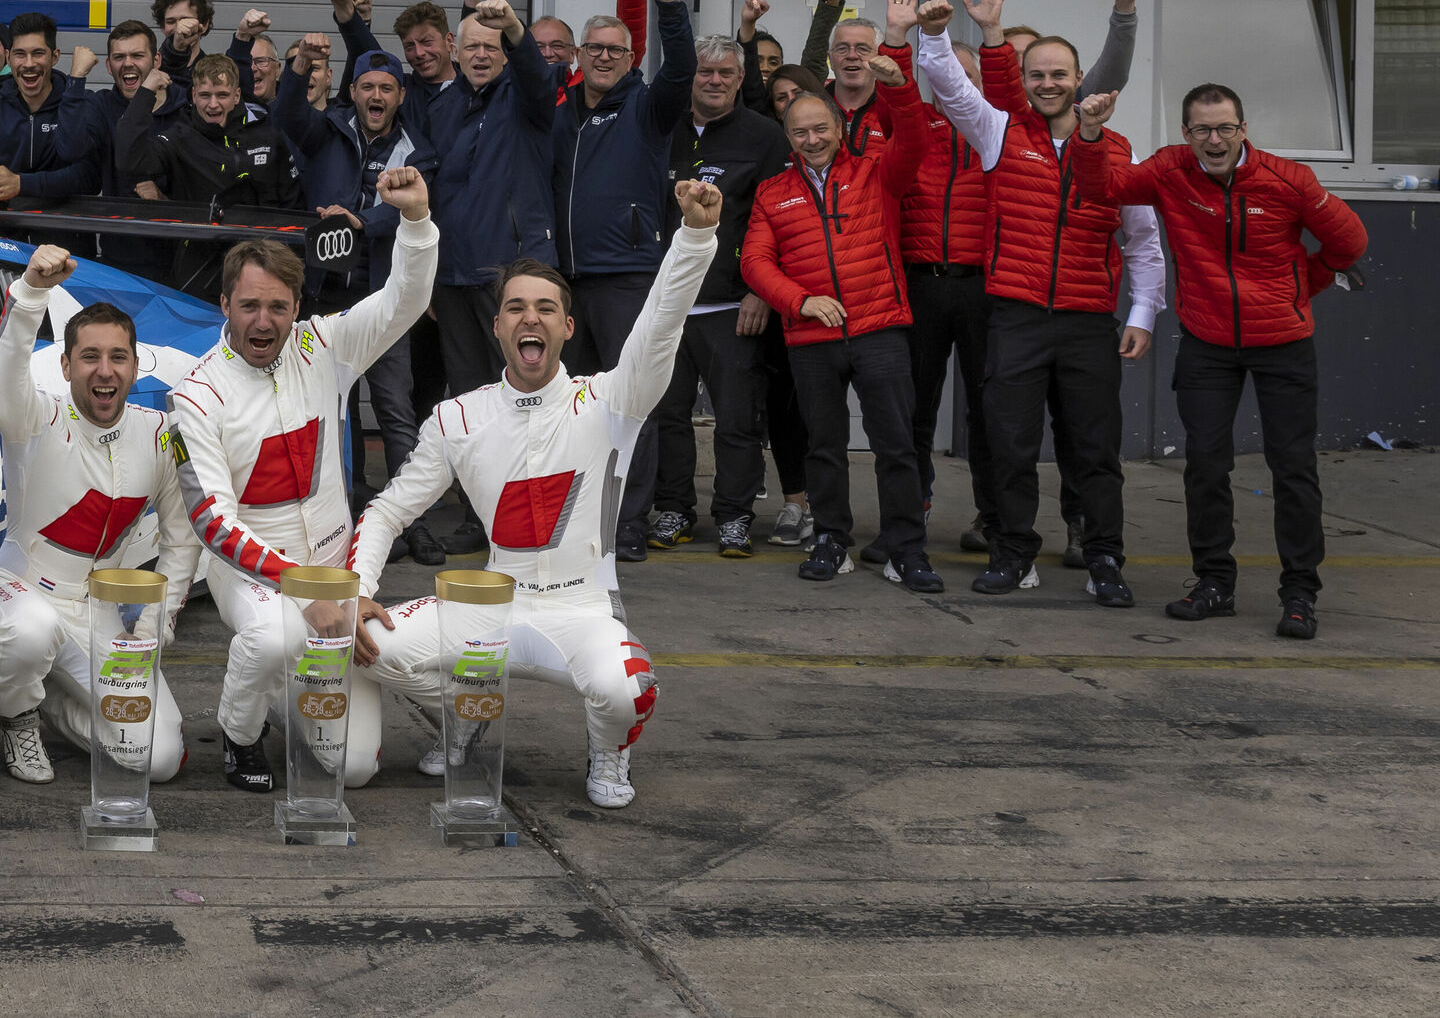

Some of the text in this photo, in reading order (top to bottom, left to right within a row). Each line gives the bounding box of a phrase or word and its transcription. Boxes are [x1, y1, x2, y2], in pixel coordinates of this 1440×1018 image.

[316, 523, 347, 550] VERVISCH
[546, 582, 561, 592] DER
[563, 577, 585, 589] LINDE
[398, 596, 438, 619] Sport
[98, 677, 148, 690] nürburgring
[294, 674, 343, 686] nürburgring
[451, 675, 501, 687] nürburgring
[119, 729, 133, 744] 1.
[317, 726, 330, 742] 1.
